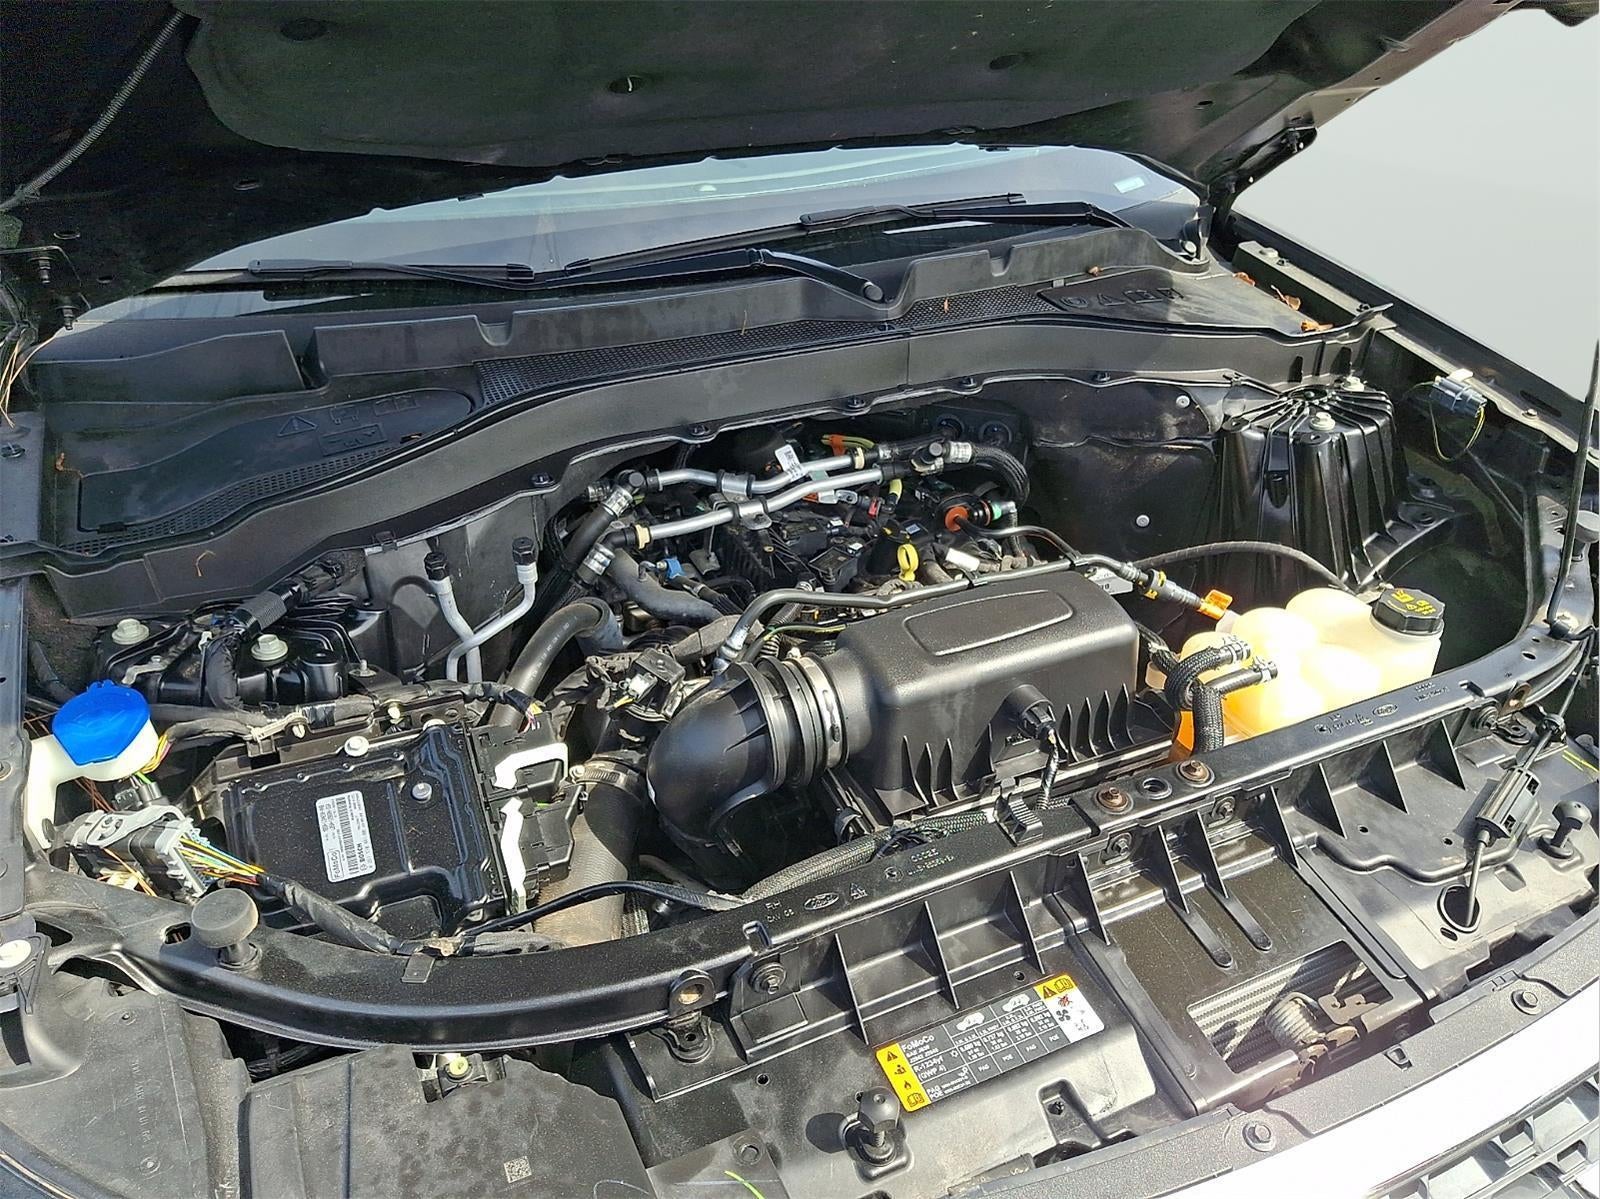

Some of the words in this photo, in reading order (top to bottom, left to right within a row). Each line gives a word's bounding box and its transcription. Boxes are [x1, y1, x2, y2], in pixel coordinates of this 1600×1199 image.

[357, 843, 365, 862] BOSCH
[331, 851, 341, 879] FoMoCo
[901, 1035, 935, 1052] FoMoCo
[1026, 1044, 1037, 1052] PAG
[913, 1055, 944, 1072] R-1234yf
[978, 1064, 990, 1072] PAG
[918, 1067, 937, 1082] (GWP
[926, 1085, 941, 1095] PAG
